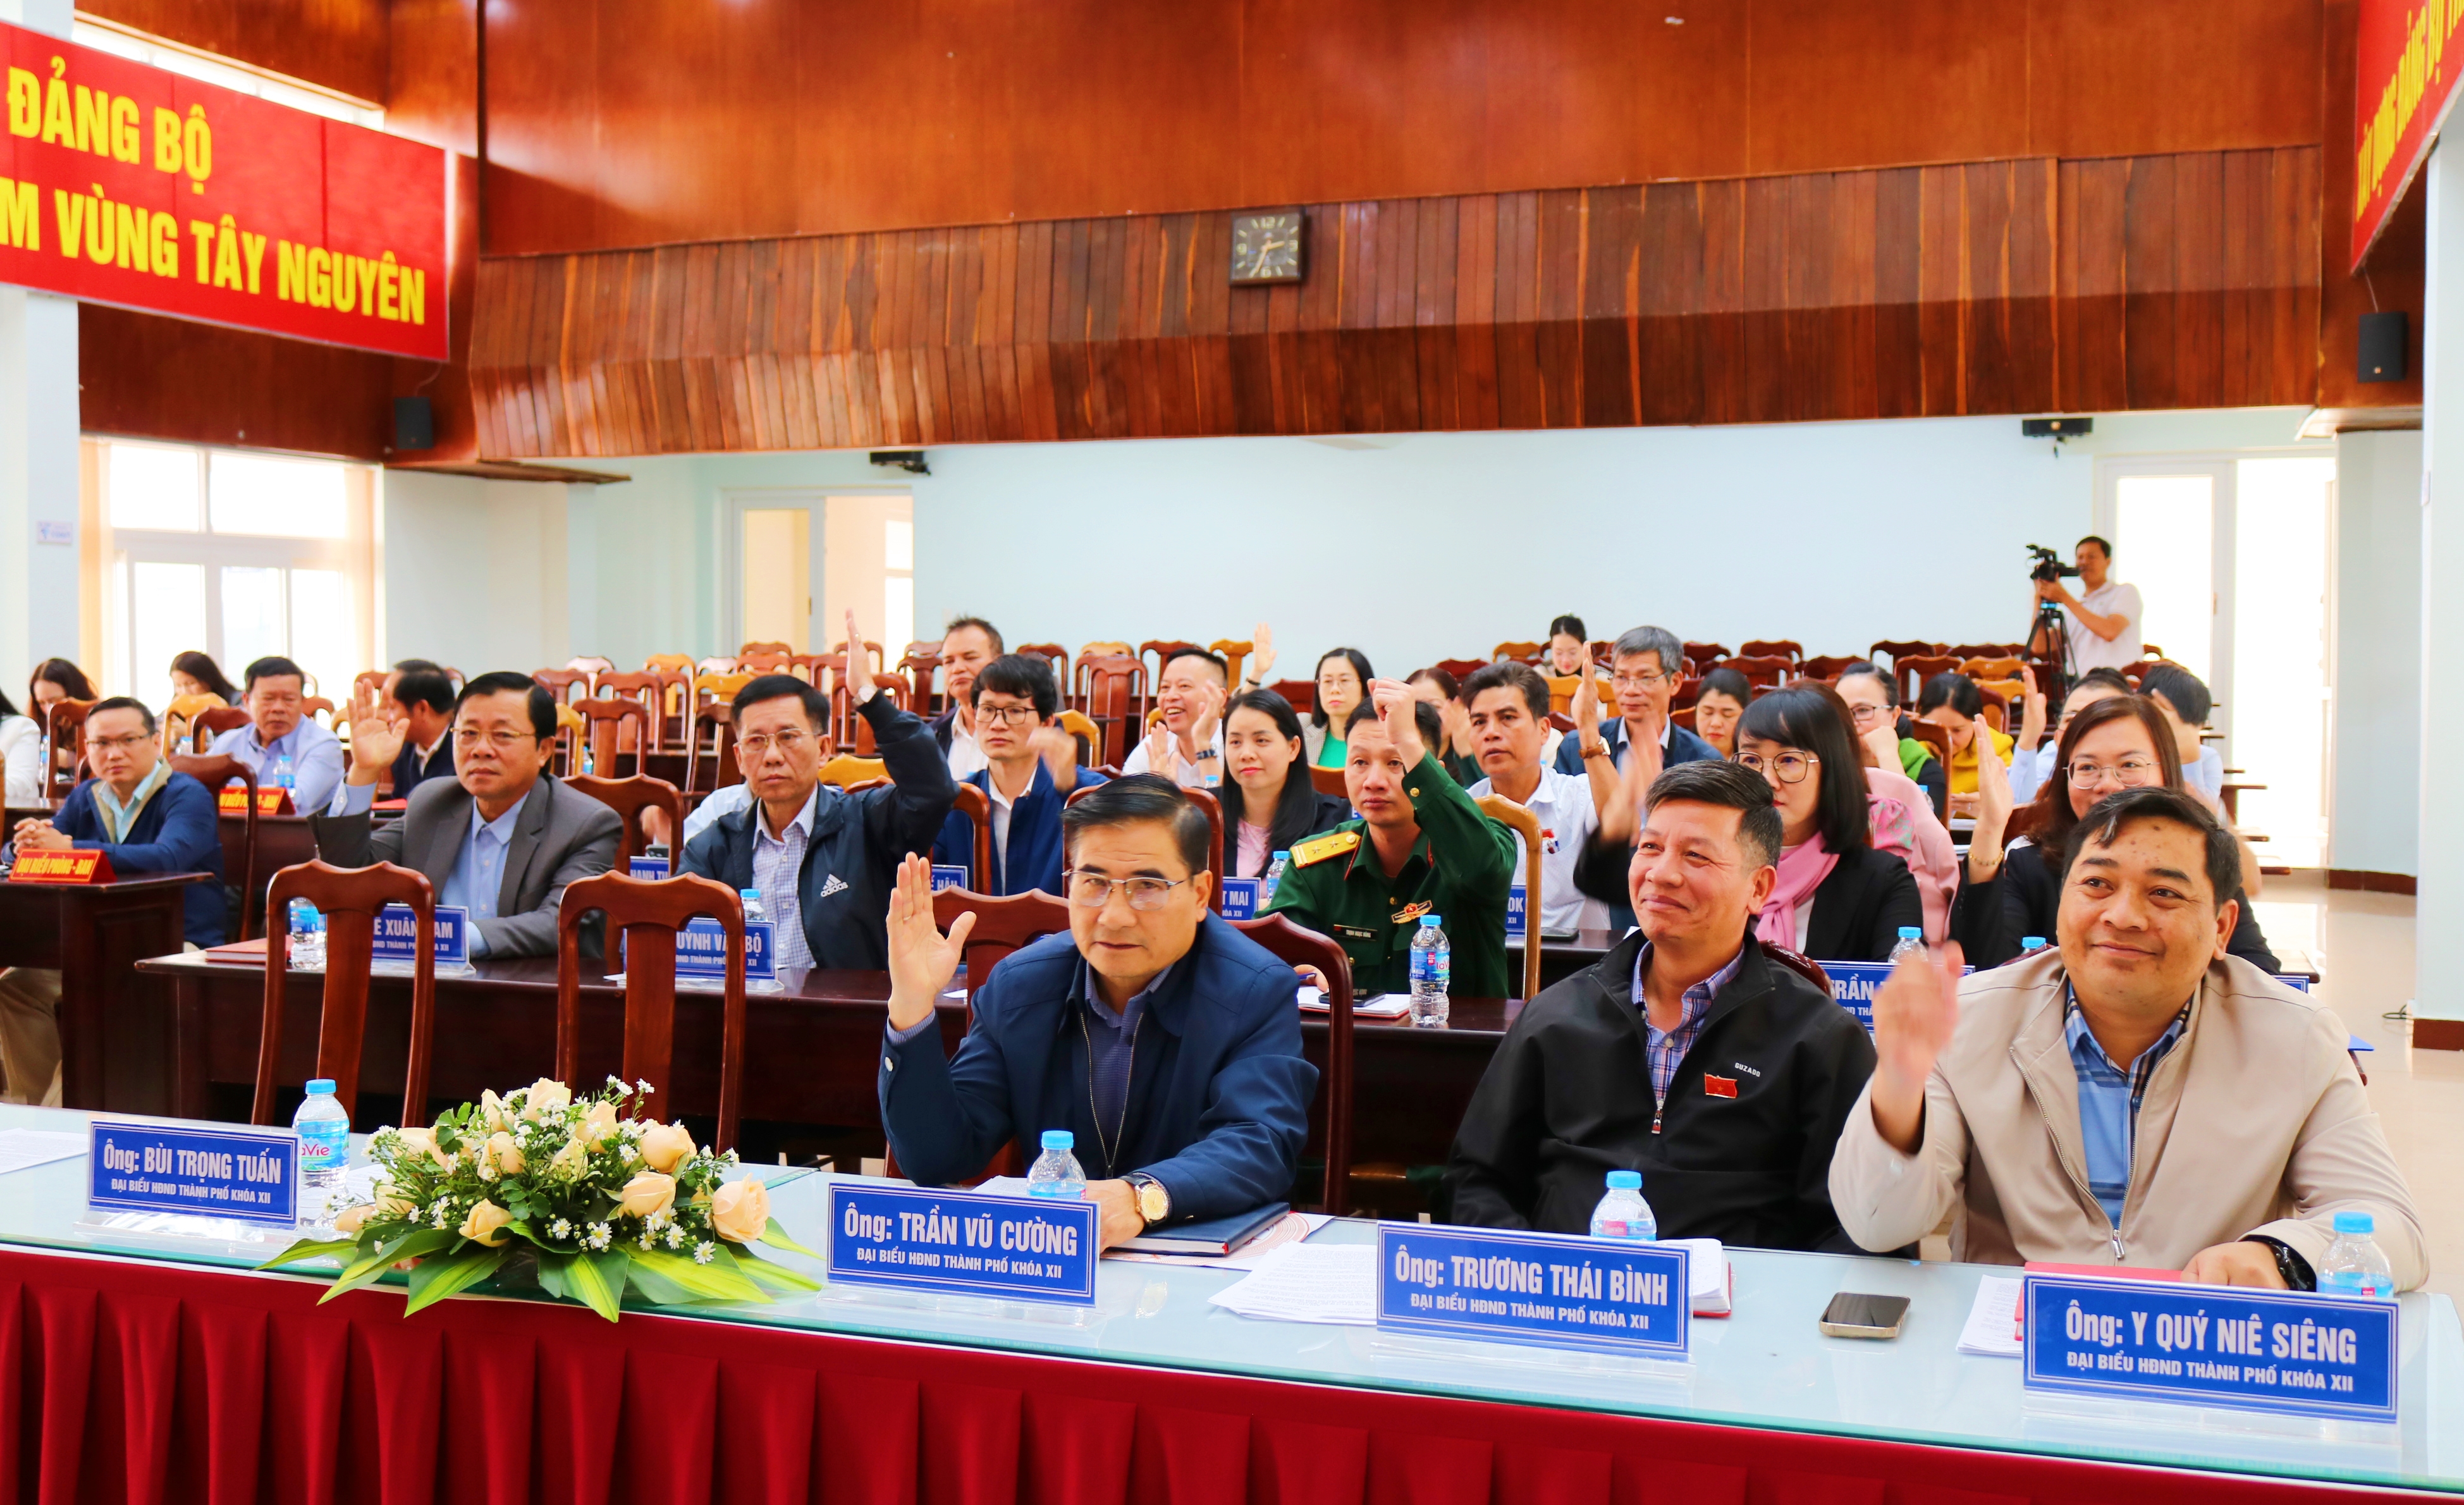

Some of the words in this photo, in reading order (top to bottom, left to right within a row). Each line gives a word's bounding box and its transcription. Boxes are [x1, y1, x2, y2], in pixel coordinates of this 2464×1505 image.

[8, 56, 140, 165] ĐẢNG
[154, 103, 212, 195] BỘ
[54, 183, 179, 278] VÙNG
[190, 214, 267, 295] TÂY
[278, 240, 426, 326] NGUYÊN
[29, 852, 51, 874] BIỂU
[75, 858, 94, 875] BAN
[821, 882, 849, 897] adidas
[1229, 890, 1249, 906] MAI
[1222, 909, 1232, 917] ÓA
[1507, 897, 1524, 912] OK
[374, 917, 382, 935] Ê
[385, 917, 417, 937] XUÂN
[434, 921, 453, 939] AM
[676, 930, 711, 951] UỲNH
[745, 932, 763, 957] BỘ
[690, 954, 712, 964] THÀNH
[747, 958, 757, 966] XII
[1831, 973, 1875, 1001] RẦN
[1857, 1005, 1873, 1016] THÀ
[104, 1138, 140, 1174] Ông:
[144, 1142, 173, 1174] BÙI
[176, 1149, 233, 1183] TRỌNG
[236, 1147, 282, 1184] TUẤN
[301, 1143, 330, 1157] aVie
[111, 1178, 127, 1193] ĐẠI
[128, 1176, 150, 1193] BIỂU
[151, 1181, 177, 1195] HĐND
[178, 1183, 209, 1198] THÀNH
[210, 1184, 230, 1200] PHỐ
[231, 1188, 256, 1203] KHÓA
[257, 1191, 271, 1205] XII
[844, 1202, 893, 1243] Ông:
[898, 1204, 958, 1246] TRẦN
[964, 1212, 993, 1249] VŨ
[1000, 1215, 1077, 1256] CƯỜNG
[856, 1247, 876, 1264] ĐẠI
[879, 1245, 906, 1264] BIỂU
[908, 1251, 941, 1267] HĐND
[943, 1253, 982, 1271] THÀNH
[984, 1255, 1009, 1274] PHỐ
[1010, 1260, 1043, 1277] KHÓA
[1045, 1264, 1062, 1279] XII
[1395, 1244, 1445, 1289] Ông:
[1451, 1255, 1543, 1295] TRƯƠNG
[1549, 1260, 1602, 1300] THÁI
[1609, 1263, 1668, 1306] BÌNH
[1410, 1293, 1433, 1311] ĐẠI
[1436, 1292, 1467, 1312] BIỂU
[1469, 1298, 1507, 1316] HĐND
[1510, 1301, 1555, 1320] THÀNH
[1558, 1305, 1586, 1324] PHỐ
[1589, 1309, 1627, 1328] KHÓA
[1629, 1313, 1650, 1330] XII
[2066, 1299, 2123, 1348] Ông:
[2131, 1311, 2148, 1346] Y
[2155, 1309, 2209, 1352] QUÝ
[2217, 1313, 2264, 1356] NIÊ
[2271, 1317, 2357, 1365] SIÊNG
[2067, 1351, 2093, 1371] ĐẠI
[2097, 1349, 2135, 1372] BIỂU
[2138, 1357, 2182, 1376] HĐND
[2186, 1360, 2240, 1382] THÀNH
[2243, 1363, 2277, 1385] PHỐ
[2281, 1368, 2327, 1390] KHÓA
[2330, 1373, 2354, 1392] XII
